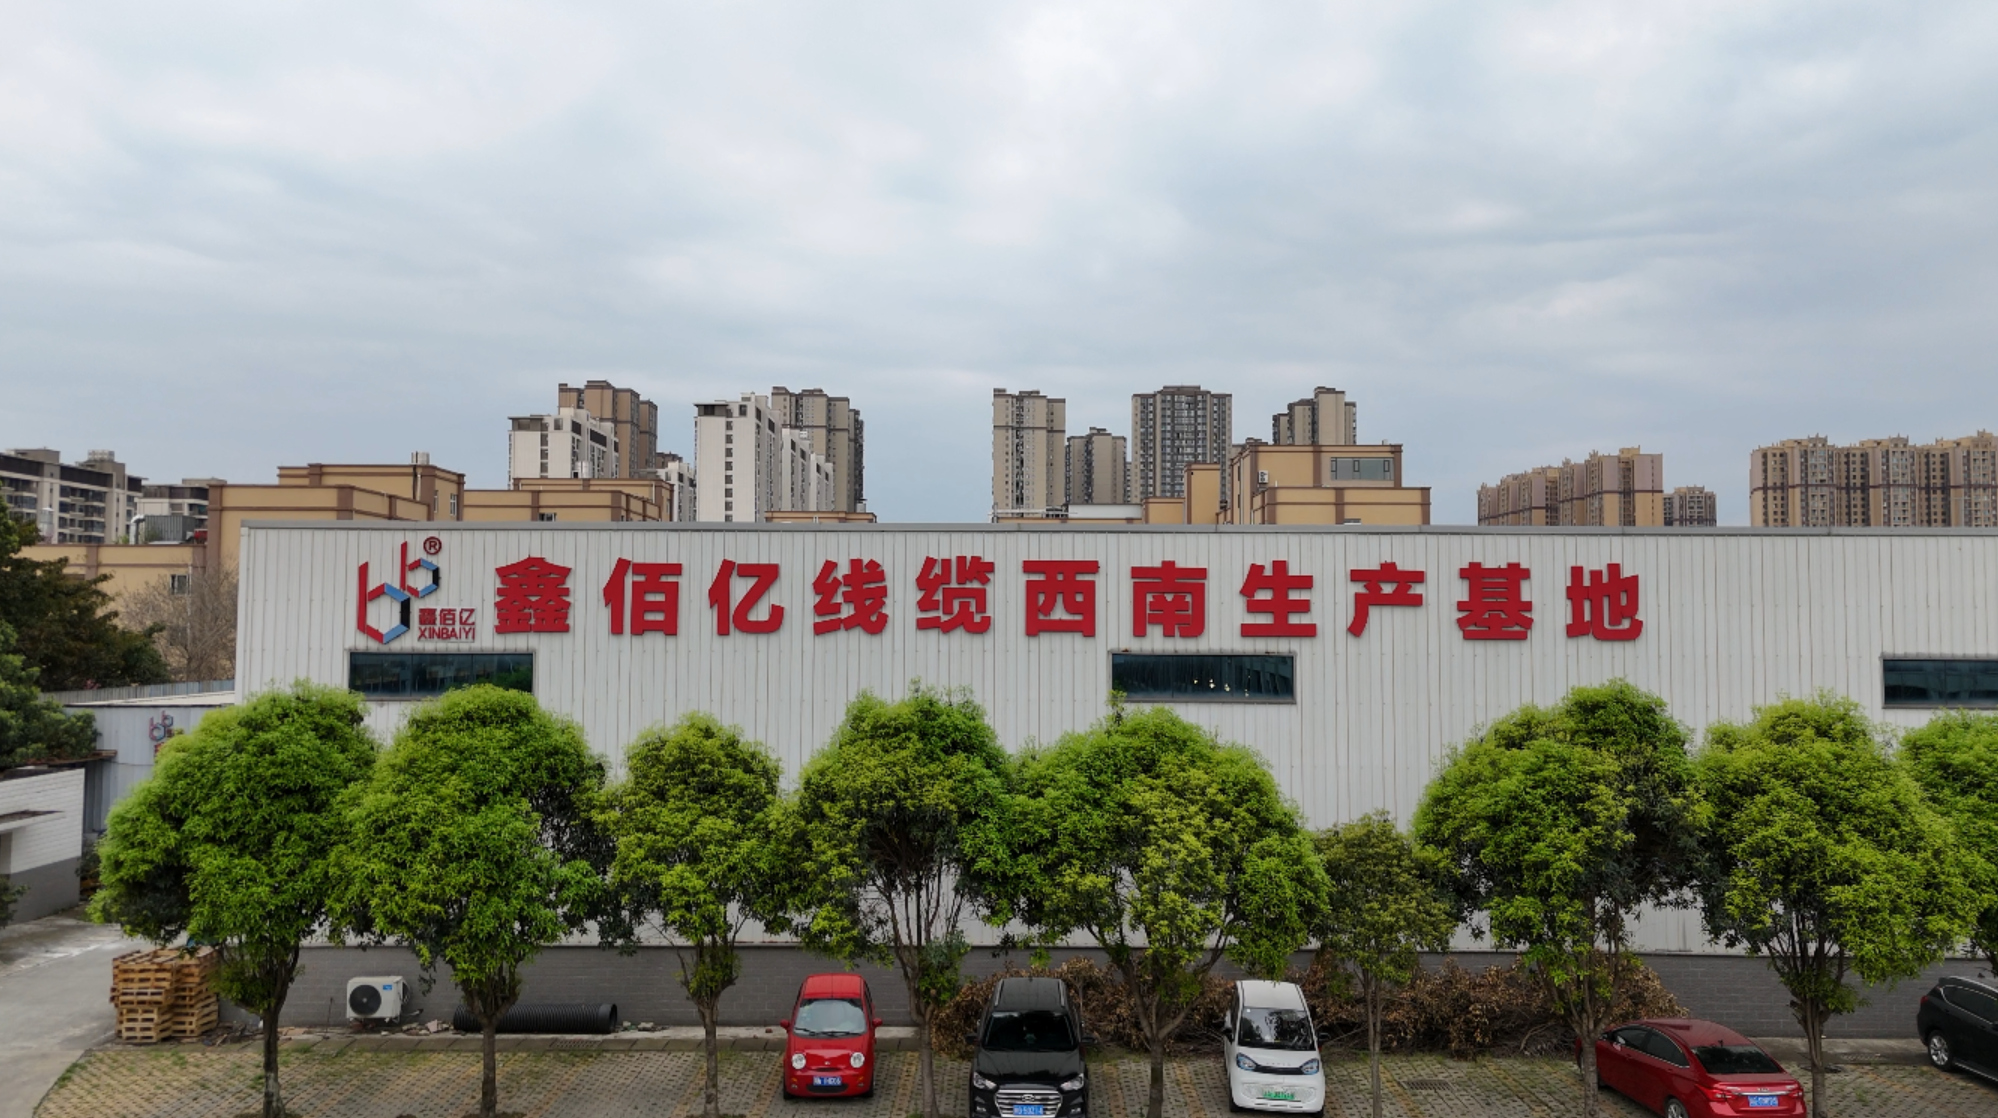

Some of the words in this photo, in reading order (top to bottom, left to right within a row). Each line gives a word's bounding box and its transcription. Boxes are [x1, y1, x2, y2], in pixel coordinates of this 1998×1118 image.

[494, 556, 1644, 641] 鑫佰亿线缆西南生产基地
[418, 626, 475, 640] XINBAIYI
